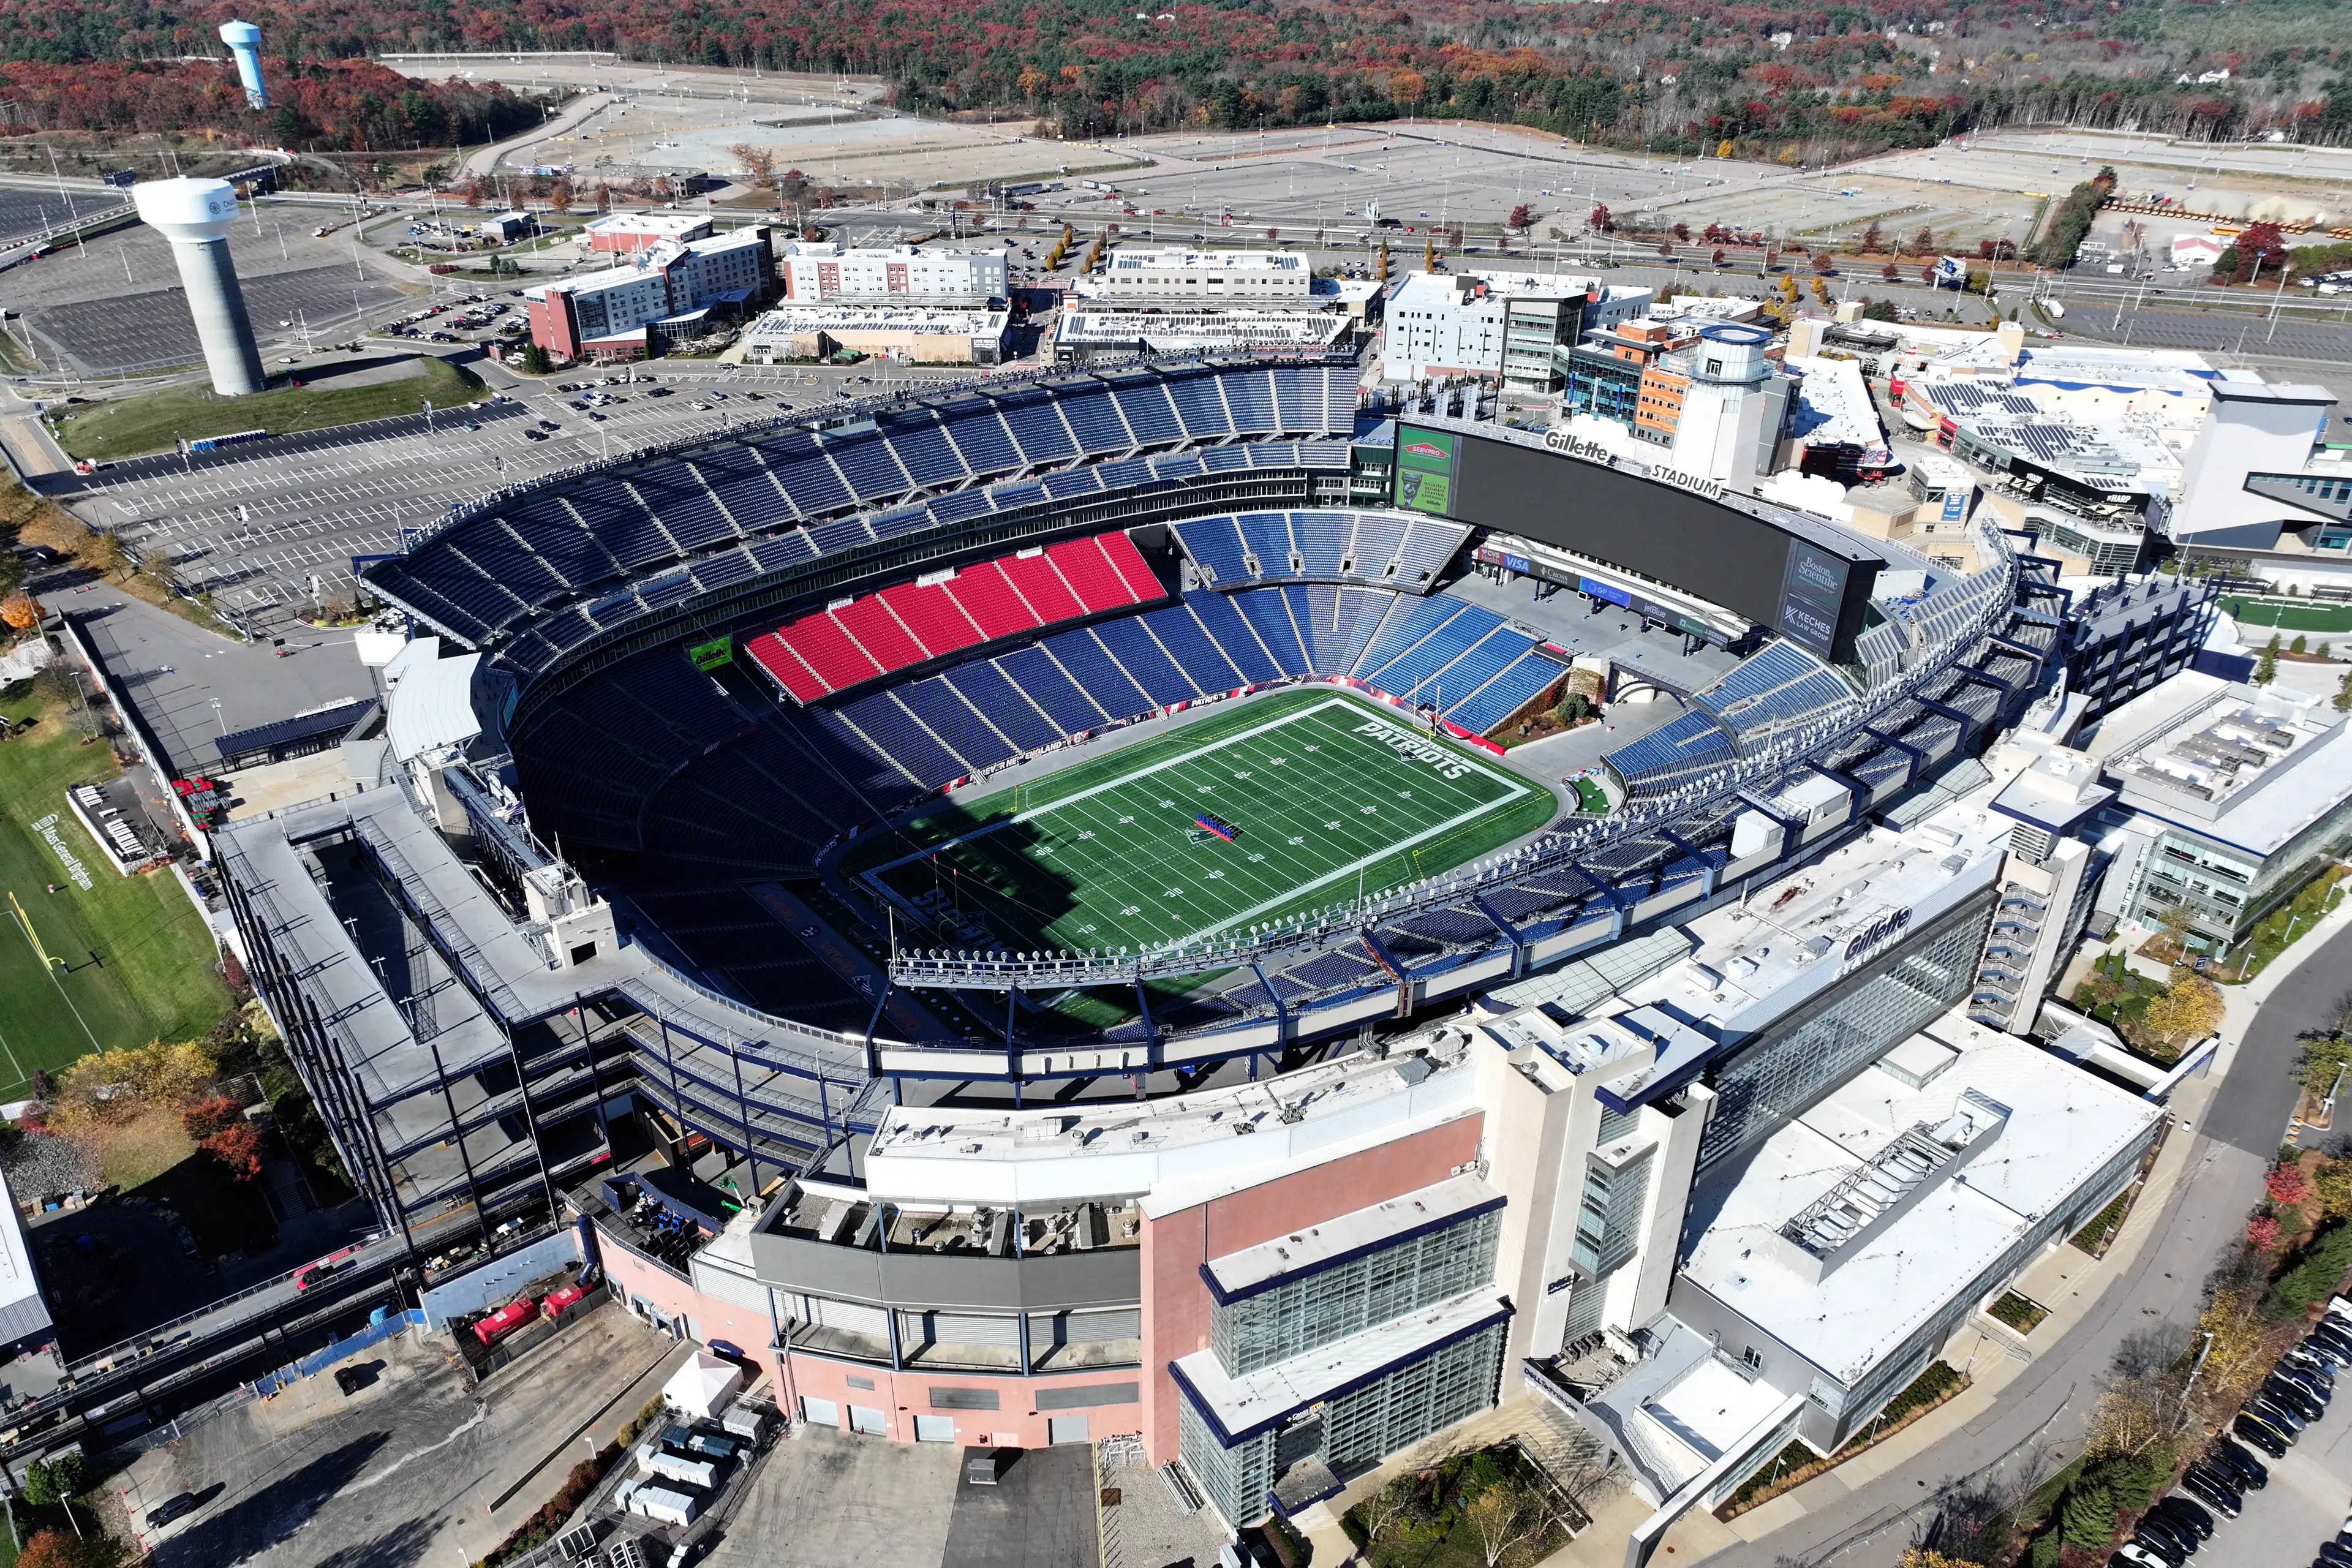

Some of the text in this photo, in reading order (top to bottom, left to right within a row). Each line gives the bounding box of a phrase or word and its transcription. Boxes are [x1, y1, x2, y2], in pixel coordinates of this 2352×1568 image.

[1545, 431, 1608, 462] Gillette
[1652, 464, 1720, 497] STADIUM
[2030, 473, 2043, 483] HARP
[2112, 494, 2132, 503] HARP
[1481, 554, 1500, 564] Health
[1487, 550, 1500, 559] CVS
[1506, 556, 1529, 571] VISA
[1806, 557, 1831, 577] Boston
[1799, 561, 1838, 590] Scientific
[1643, 603, 1666, 618] jetBlue
[1798, 611, 1831, 634] KECHES
[1796, 621, 1829, 641] LAW GROUP
[696, 648, 726, 664] Gillette
[1191, 693, 1227, 707] PATRIOTS
[1399, 729, 1424, 742] TAKES
[1425, 741, 1440, 750] ALL
[1025, 741, 1063, 760] ENGLAND
[1351, 722, 1472, 780] PATRIOTS
[1360, 805, 1377, 815] 20
[1121, 815, 1134, 823] 40
[1197, 813, 1232, 839] PATRIOTS
[1324, 821, 1341, 830] 30
[1079, 831, 1096, 839] 30
[1288, 836, 1303, 846] 40
[1038, 846, 1054, 856] 20
[1247, 853, 1265, 863] 50
[41, 826, 93, 891] Mass General Brigham
[1208, 870, 1226, 879] 40
[1167, 888, 1184, 897] 30
[1123, 905, 1140, 915] 20
[1082, 924, 1096, 933] 10
[1844, 907, 1910, 961] Gillette
[1524, 1367, 1541, 1385] DELL
[1541, 1380, 1578, 1412] Technologies
